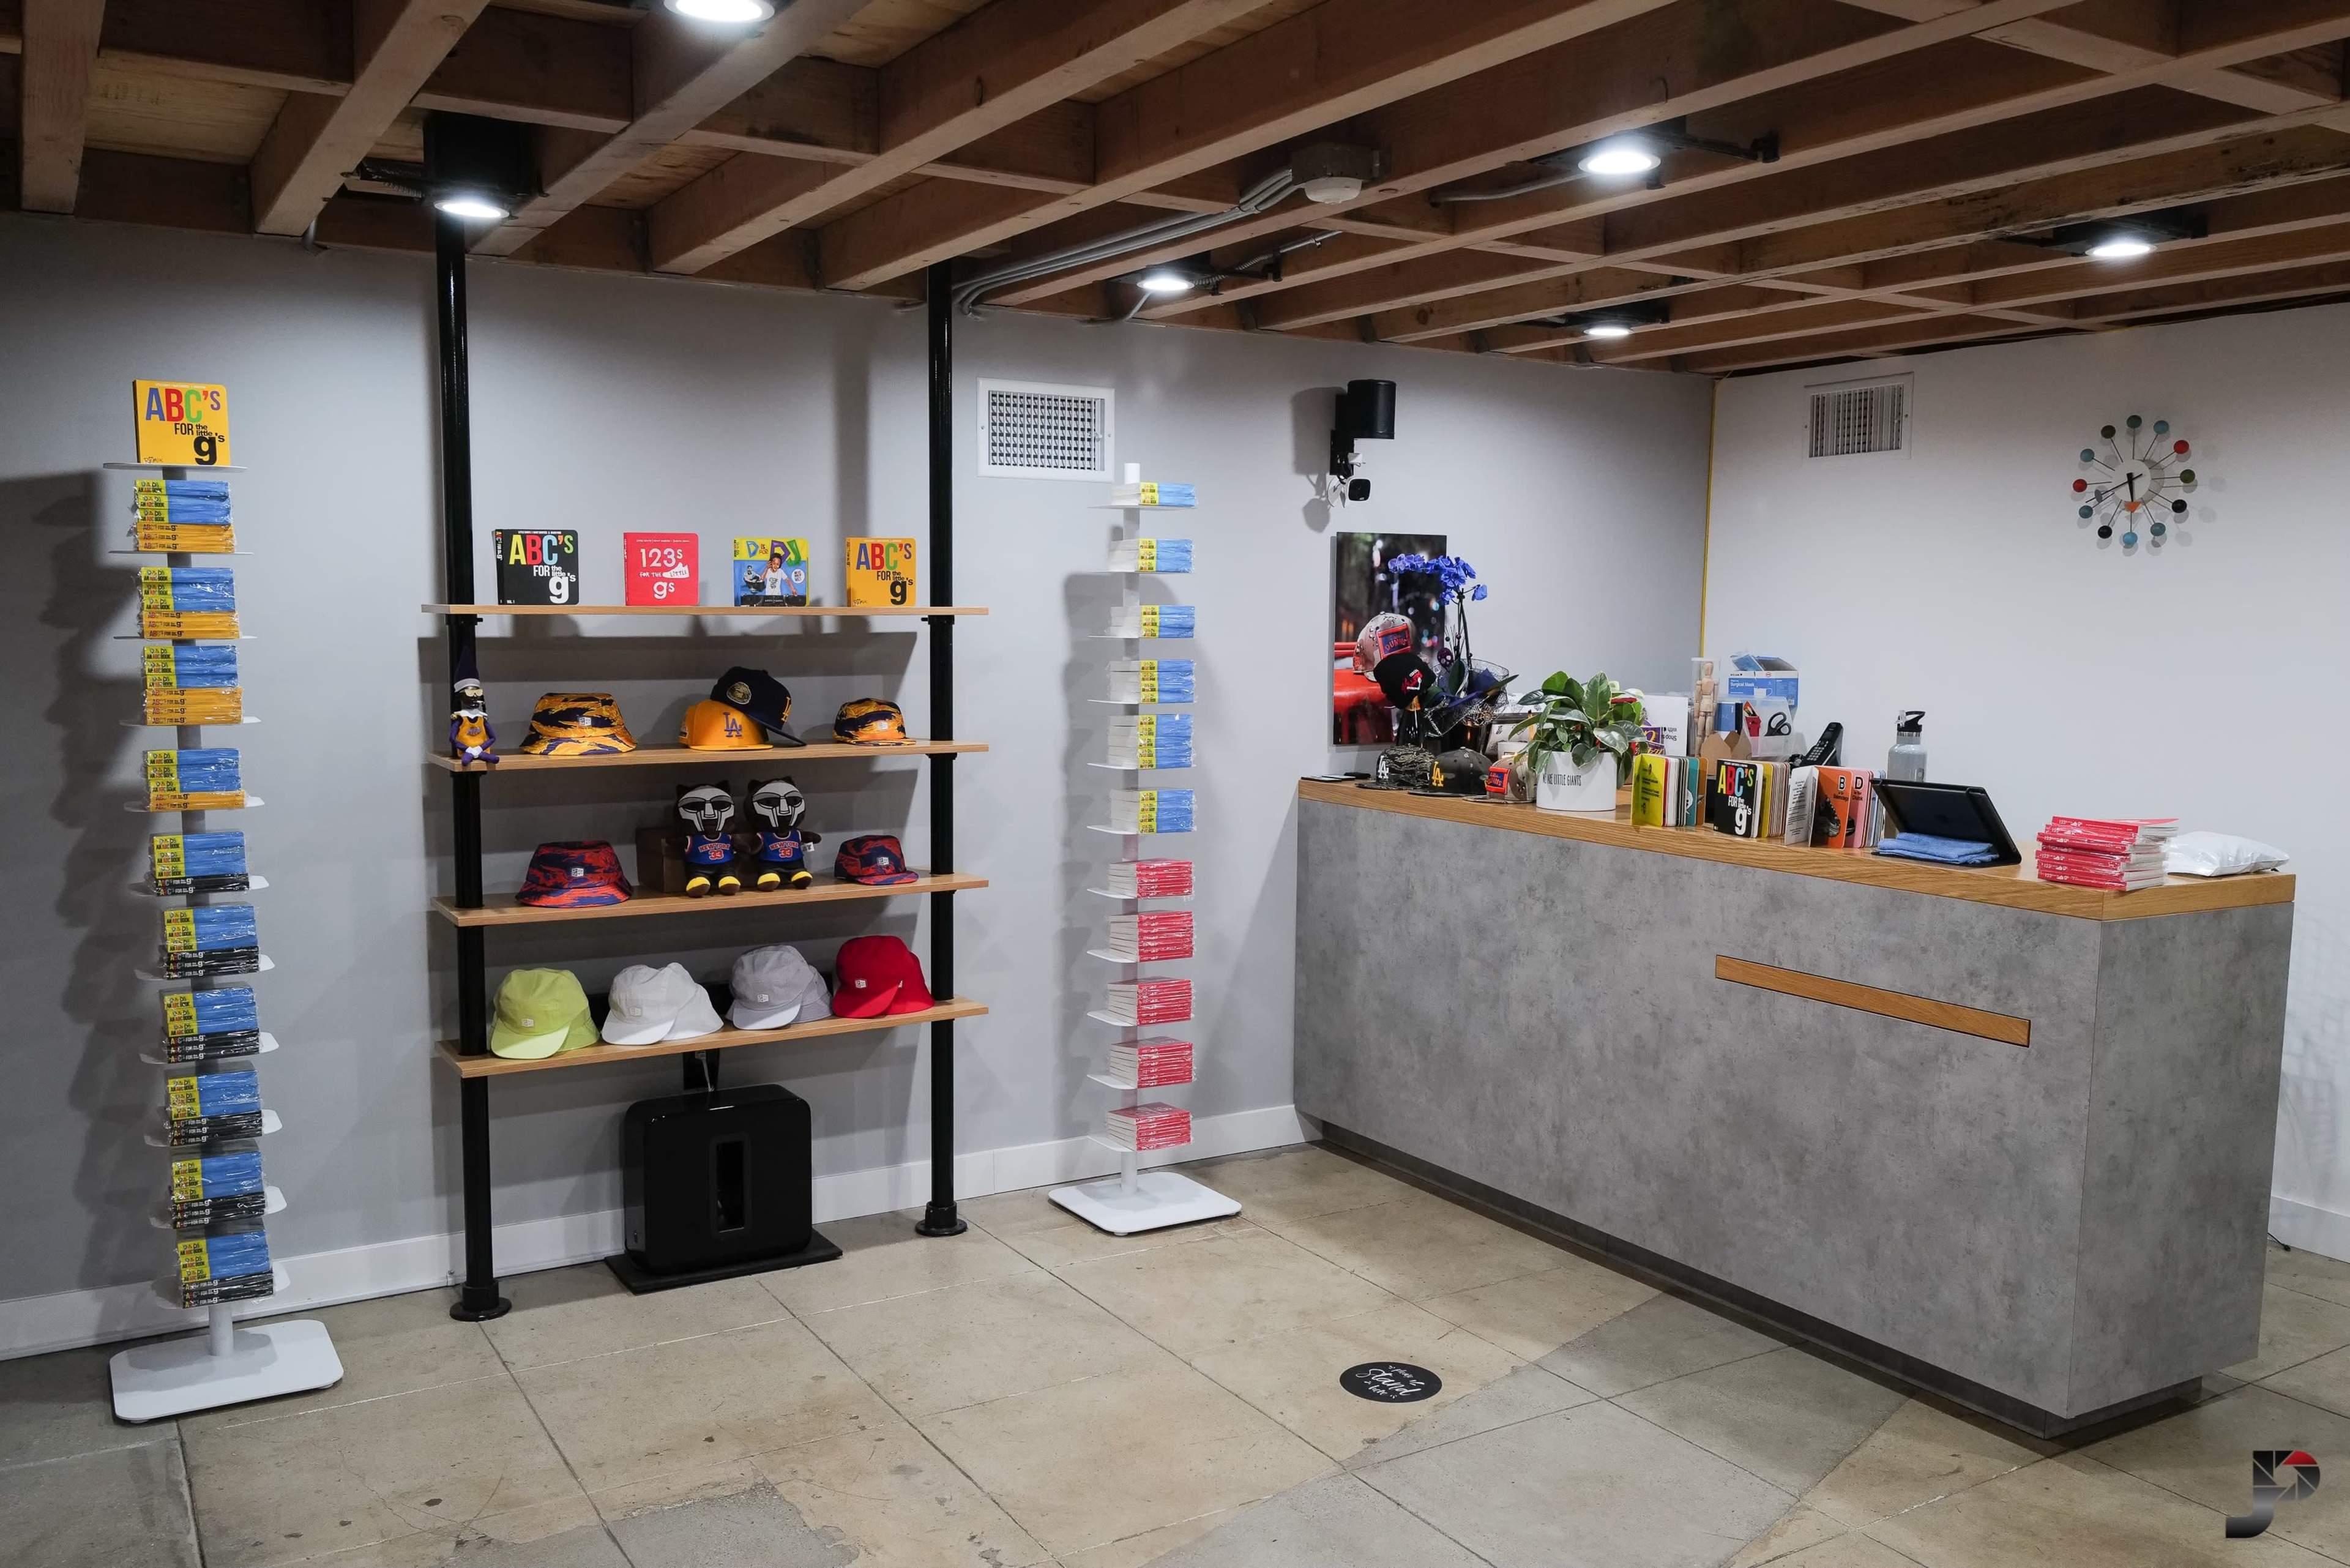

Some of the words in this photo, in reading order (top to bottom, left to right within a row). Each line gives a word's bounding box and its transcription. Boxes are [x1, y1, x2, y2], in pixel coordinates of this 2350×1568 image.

[146, 387, 220, 422] ABC'S
[174, 423, 193, 435] FOR
[509, 535, 573, 565] ABC'S
[747, 541, 758, 558] D
[856, 543, 912, 570] ABC'S
[534, 566, 550, 577] FOR
[877, 571, 890, 580] FOR
[723, 712, 742, 737] LA
[1378, 755, 1389, 778] LA
[1432, 761, 1444, 786] LA
[1554, 774, 1565, 785] LITTLE
[1567, 775, 1581, 786] GIANTS
[1717, 765, 1753, 796] ABC'S
[1839, 776, 1846, 790] B
[1854, 776, 1863, 790] D
[1728, 796, 1737, 807] FOR
[709, 849, 723, 860] 33
[1356, 1368, 1421, 1395] Stand
